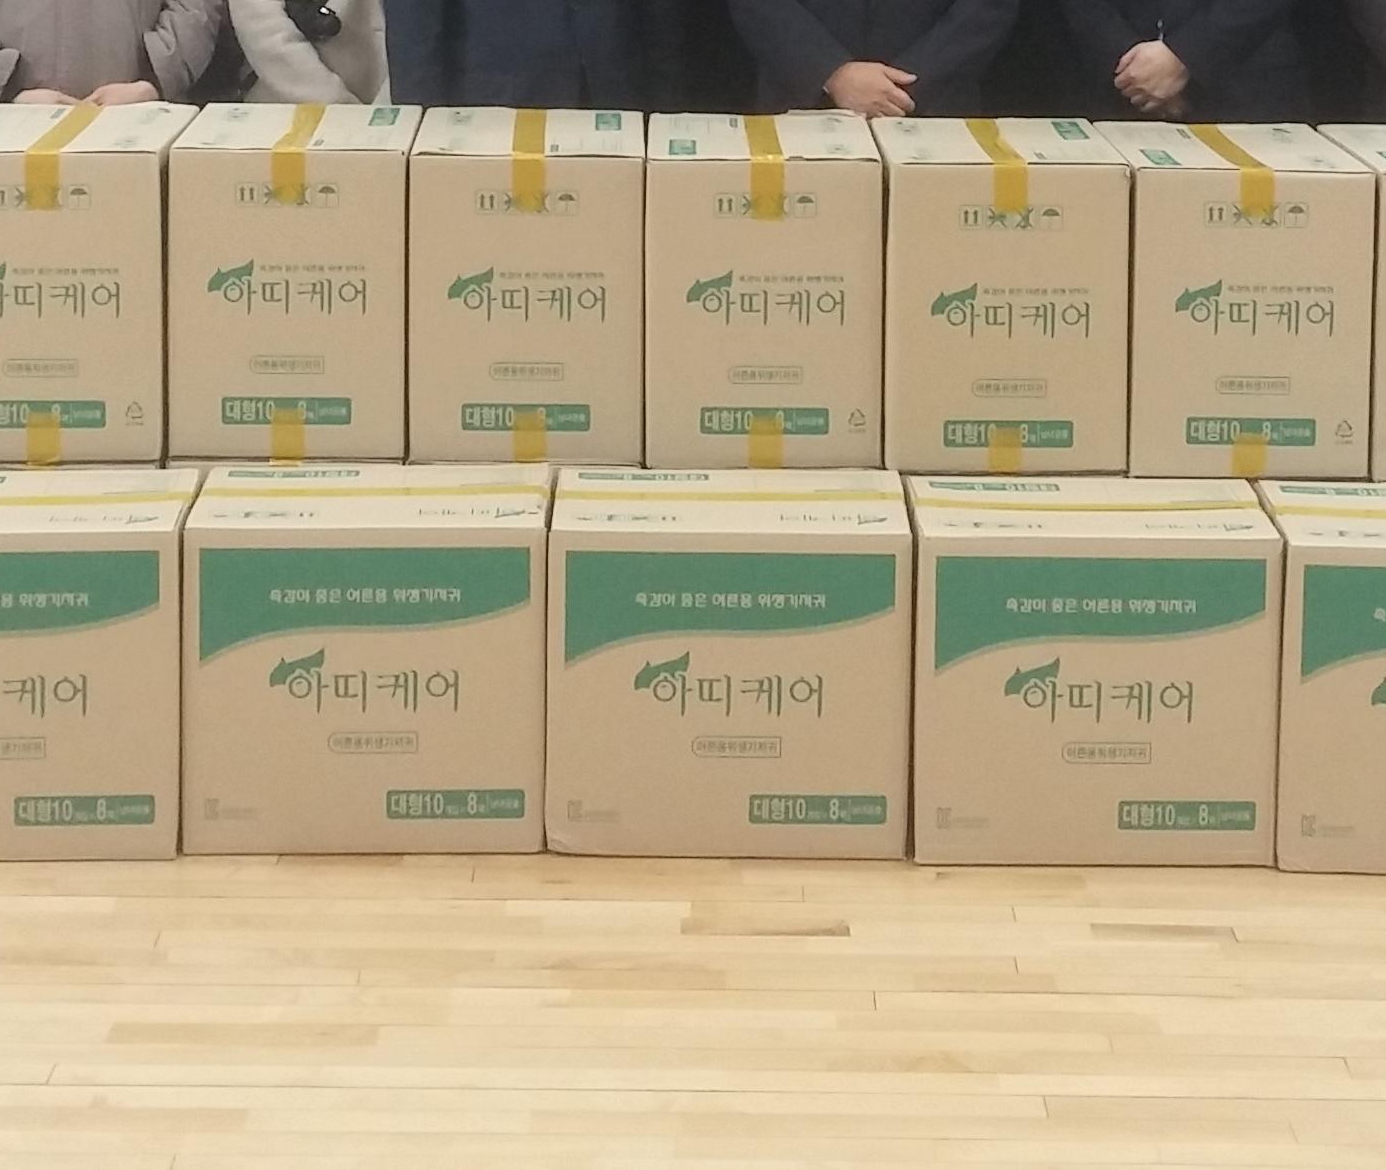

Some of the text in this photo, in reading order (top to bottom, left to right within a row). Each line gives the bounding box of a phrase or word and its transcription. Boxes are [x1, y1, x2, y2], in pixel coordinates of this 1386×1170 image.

[222, 278, 368, 315] 아띠케어
[462, 285, 607, 323] 아띠케어
[701, 288, 847, 326] 아띠케어
[946, 300, 1092, 338] 아띠케어
[1190, 299, 1335, 338] 아띠케어
[288, 669, 460, 712] 아띠케어
[653, 674, 823, 718] 아띠케어
[1023, 679, 1193, 723] 아띠케어
